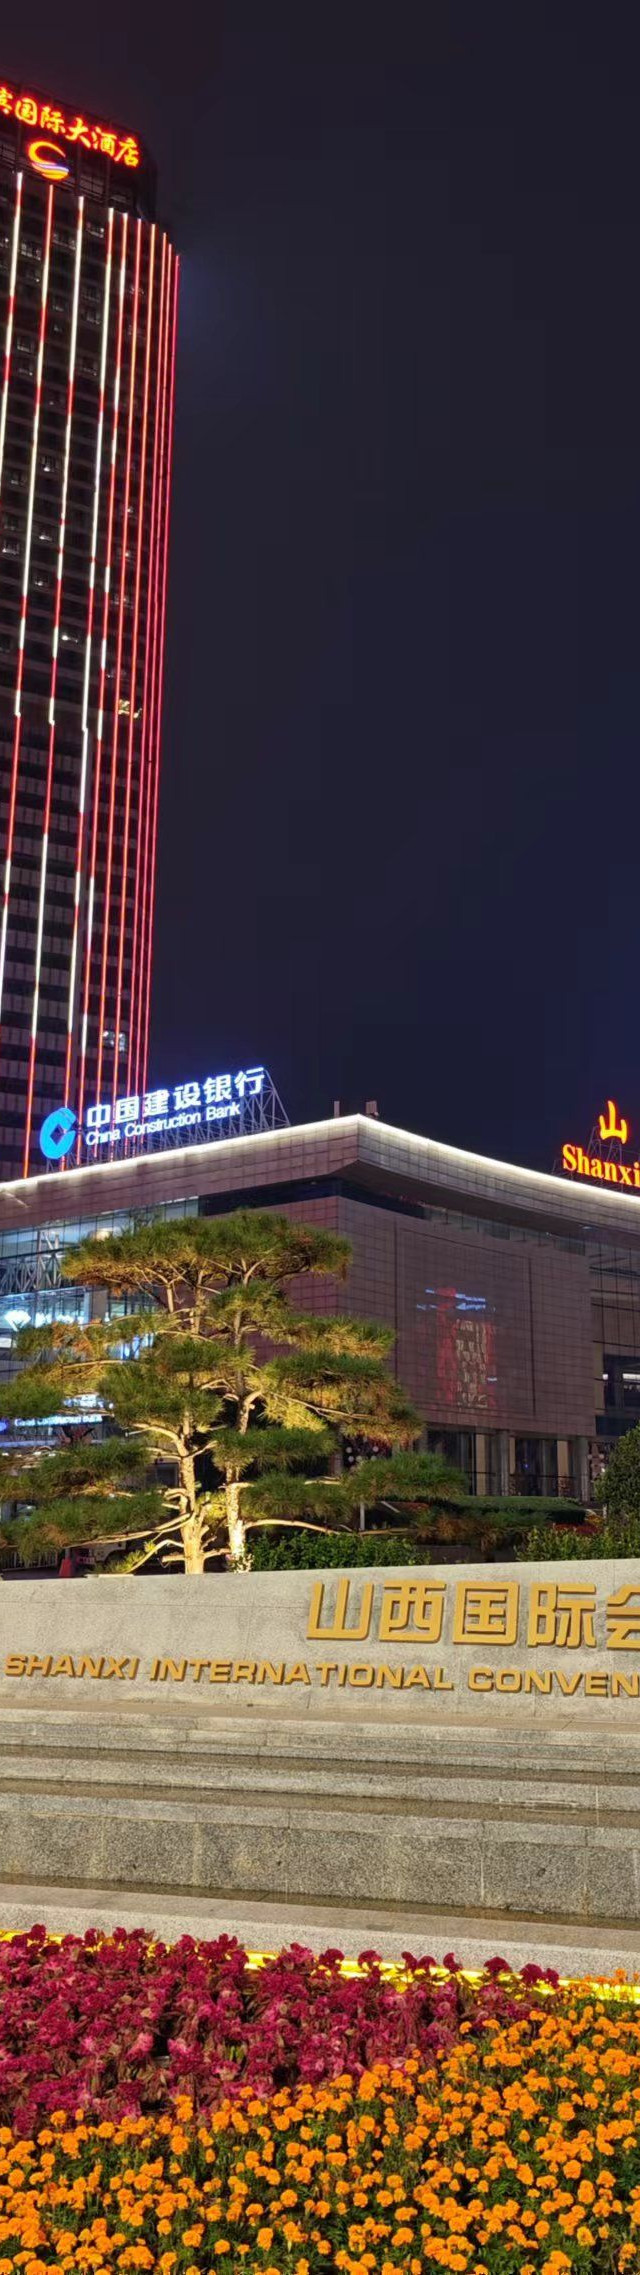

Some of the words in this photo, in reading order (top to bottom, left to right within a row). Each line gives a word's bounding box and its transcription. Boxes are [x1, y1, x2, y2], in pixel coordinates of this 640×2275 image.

[87, 1067, 265, 1128] 中国建设银行
[85, 1129, 121, 1146] China
[124, 1111, 201, 1137] Construction
[206, 1102, 241, 1121] Bank
[599, 1100, 628, 1144] 山
[562, 1143, 640, 1188] Shanxi
[4, 1653, 140, 1681] SHANXI
[149, 1656, 454, 1691] INTERNATIONAL
[466, 1666, 640, 1699] CONVEN
